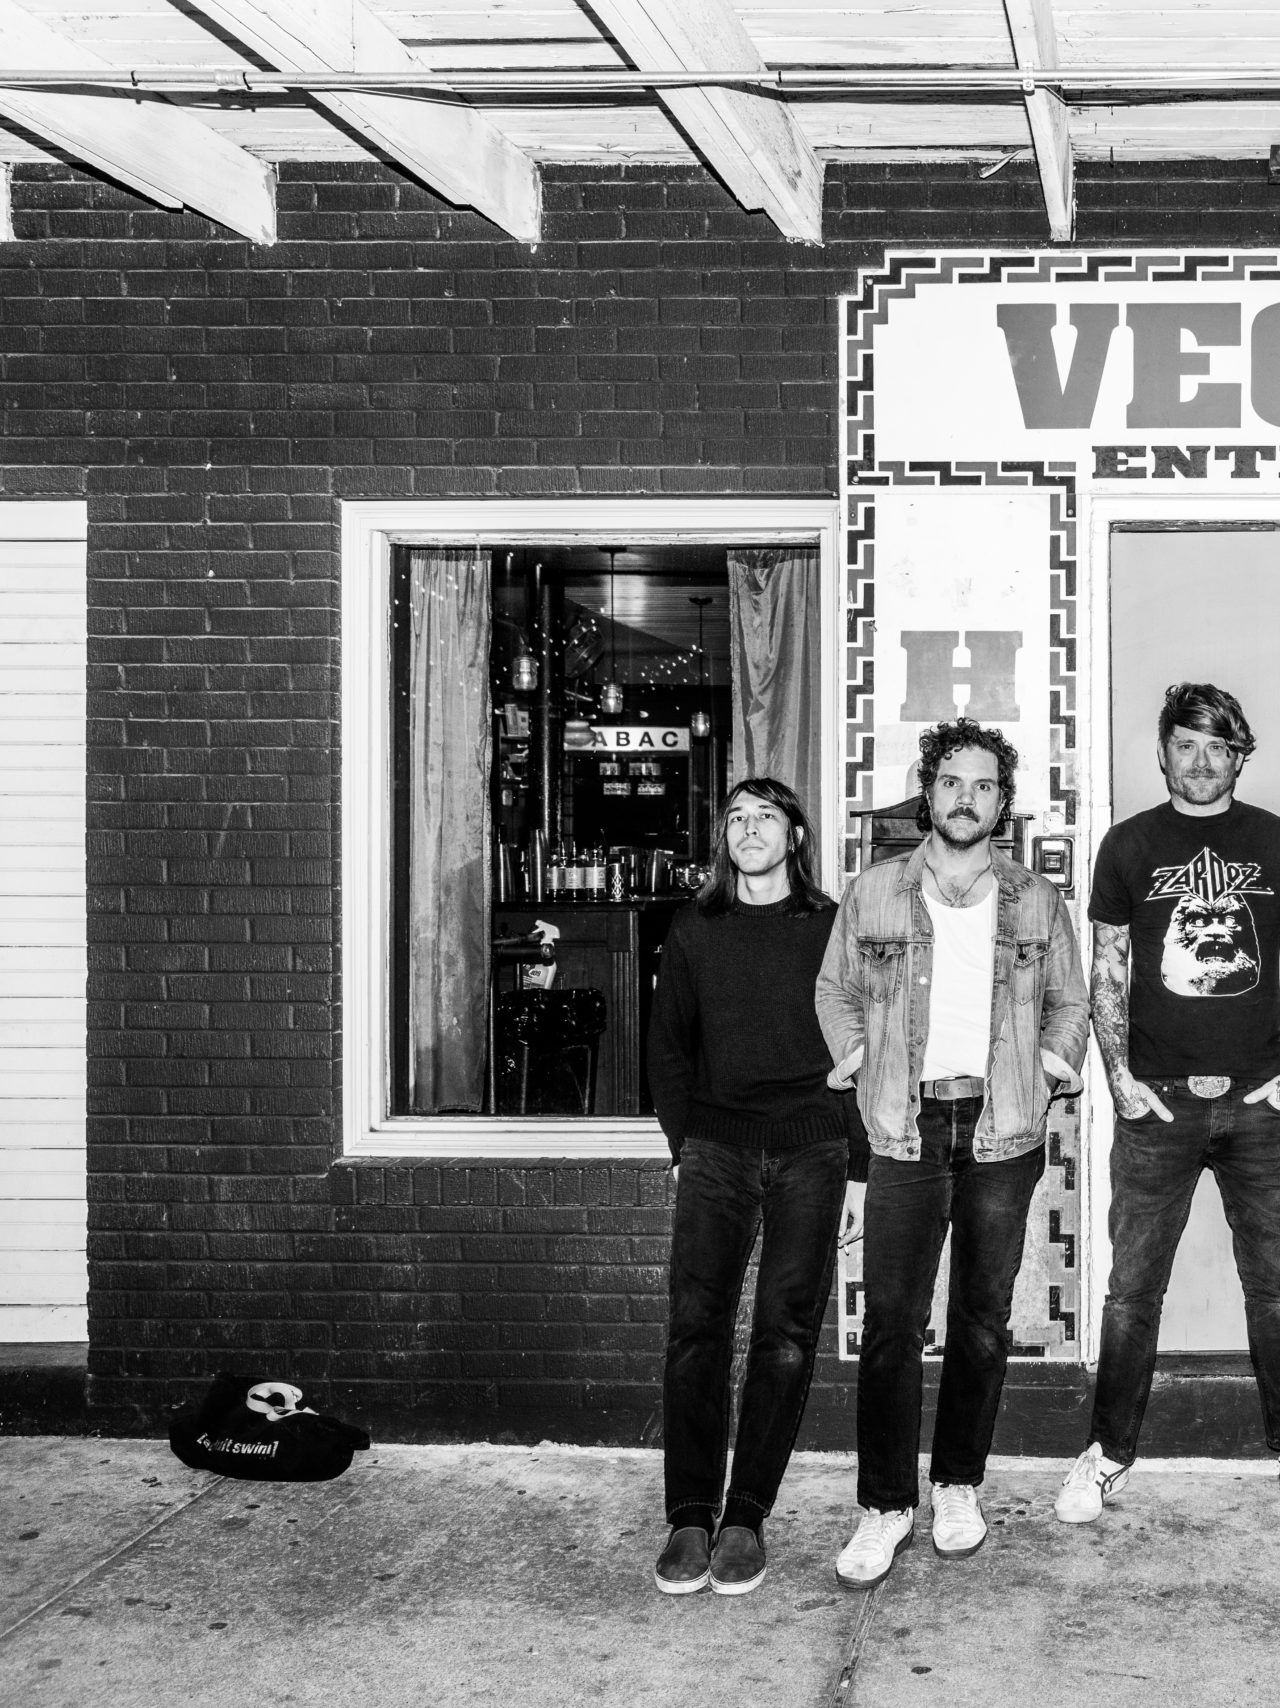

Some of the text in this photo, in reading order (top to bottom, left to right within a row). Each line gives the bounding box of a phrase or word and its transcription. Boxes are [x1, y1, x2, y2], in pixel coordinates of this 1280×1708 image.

[899, 630, 1023, 722] H
[591, 731, 679, 748] ABAC
[1144, 846, 1274, 906] ZARDOZ
